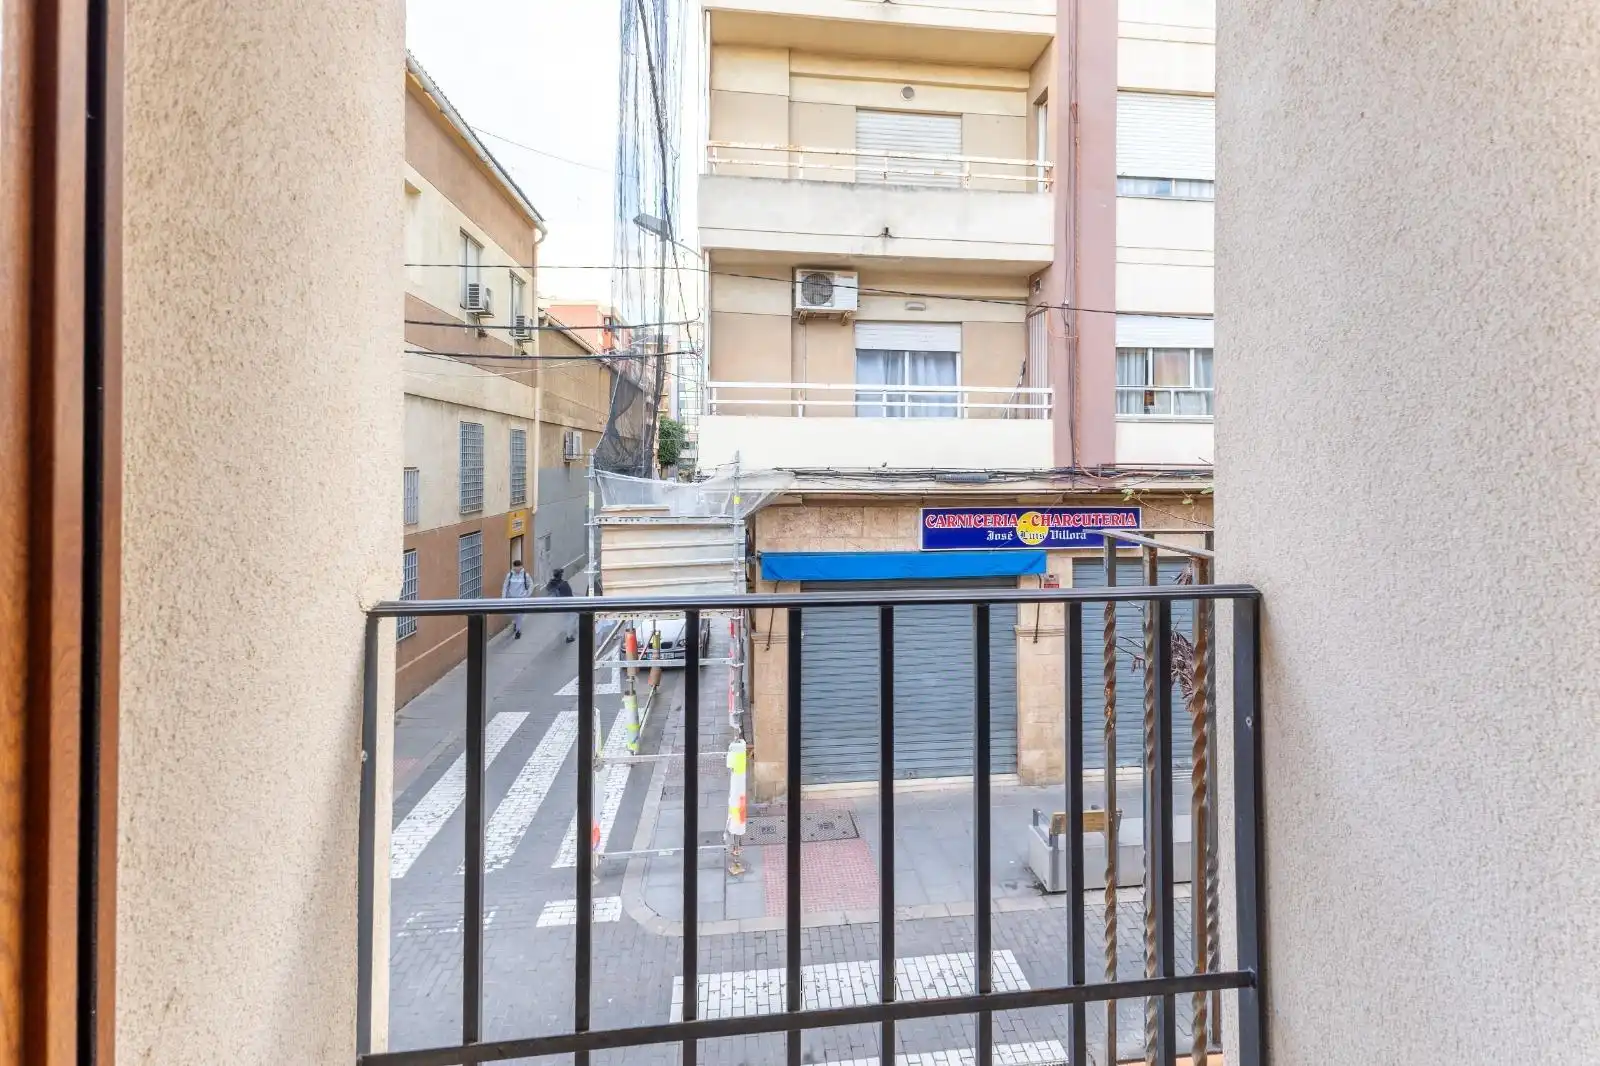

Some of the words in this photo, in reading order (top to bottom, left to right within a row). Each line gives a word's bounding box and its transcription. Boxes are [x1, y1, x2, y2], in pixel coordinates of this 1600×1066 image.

[925, 513, 1019, 528] CARNICERIA
[1031, 512, 1137, 527] CHARCUTERIA
[986, 530, 1013, 541] José
[1020, 530, 1045, 540] Luis
